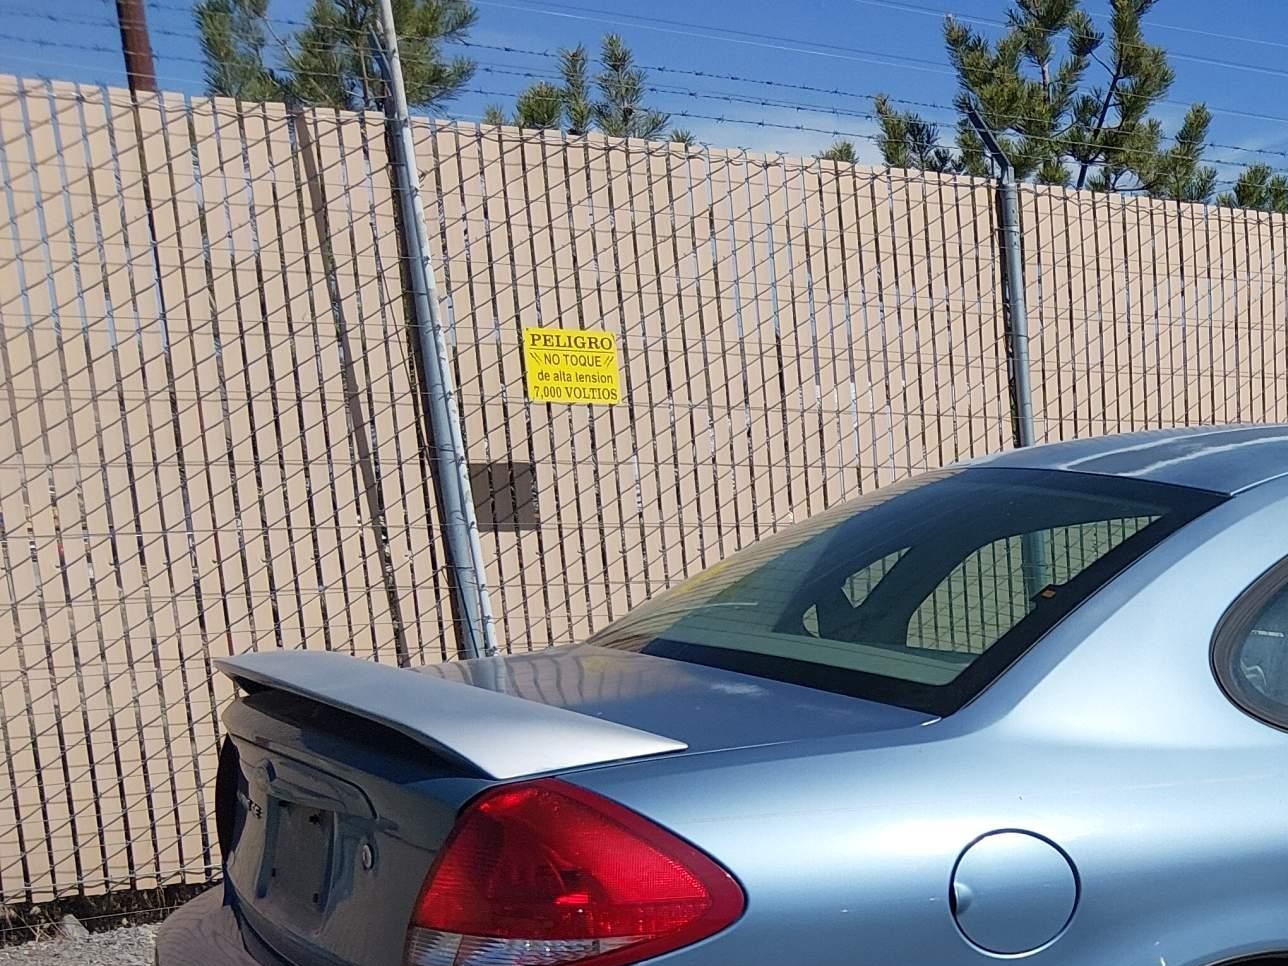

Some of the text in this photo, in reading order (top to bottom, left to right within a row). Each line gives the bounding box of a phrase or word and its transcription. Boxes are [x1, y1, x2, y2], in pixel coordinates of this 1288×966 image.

[530, 333, 612, 350] PELIGRO
[544, 354, 602, 367] NO TOQUE
[538, 370, 551, 381] de
[553, 370, 572, 382] alta
[534, 386, 617, 400] 7,000 VOLTIOS
